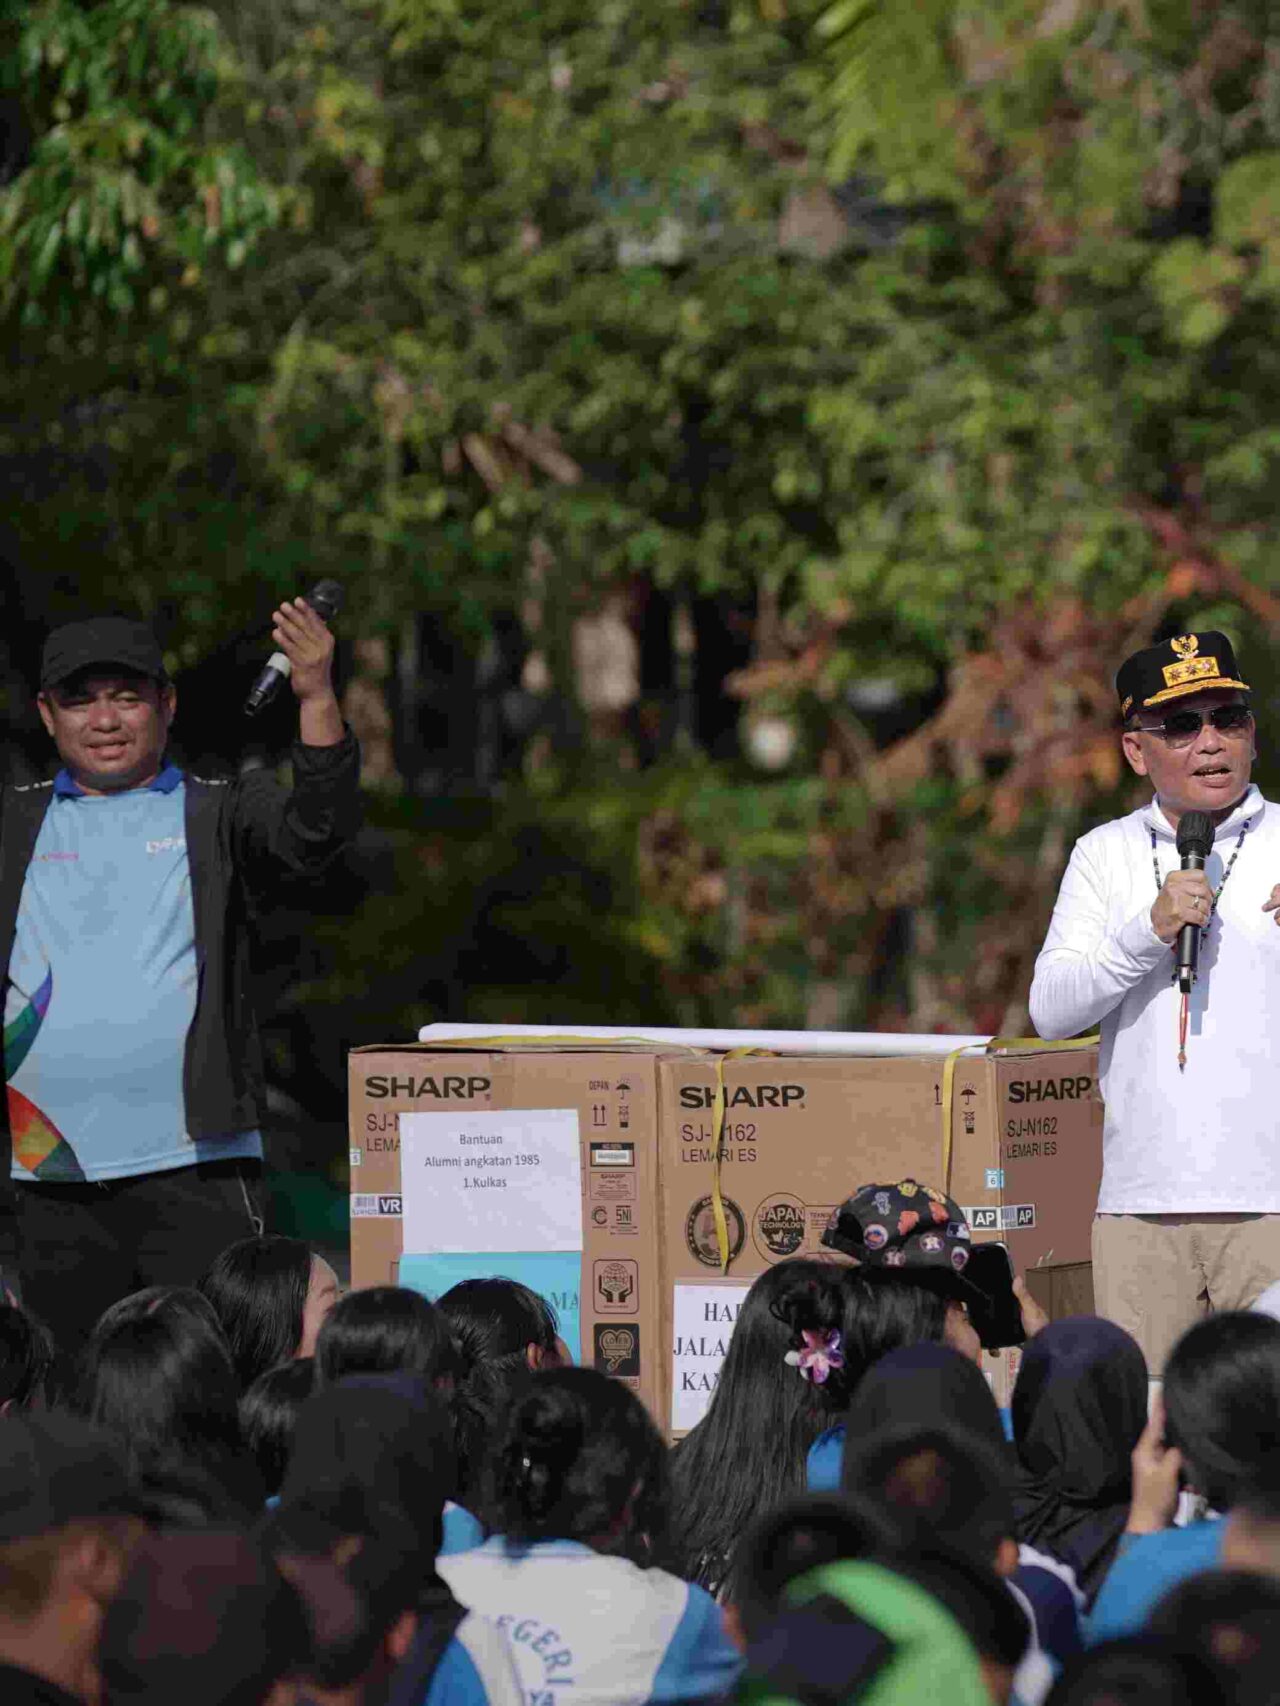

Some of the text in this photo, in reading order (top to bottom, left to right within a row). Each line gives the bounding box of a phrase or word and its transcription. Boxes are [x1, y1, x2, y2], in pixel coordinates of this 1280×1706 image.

[365, 1076, 491, 1099] SHARP
[1008, 1076, 1092, 1104] SHARP
[680, 1085, 804, 1109] SHARP
[682, 1123, 756, 1142] SJ-162
[1007, 1116, 1058, 1138] SJ-N162
[459, 1133, 503, 1146] Bantuan
[738, 1148, 757, 1162] ES
[1007, 1141, 1057, 1159] LEMARI ES
[424, 1154, 541, 1169] Alumni angkatan 1985
[463, 1177, 508, 1189] 1.Kulkas
[380, 1199, 401, 1213] VR
[760, 1206, 805, 1221] JAPAN
[974, 1211, 995, 1226] AP
[1018, 1209, 1032, 1224] AP
